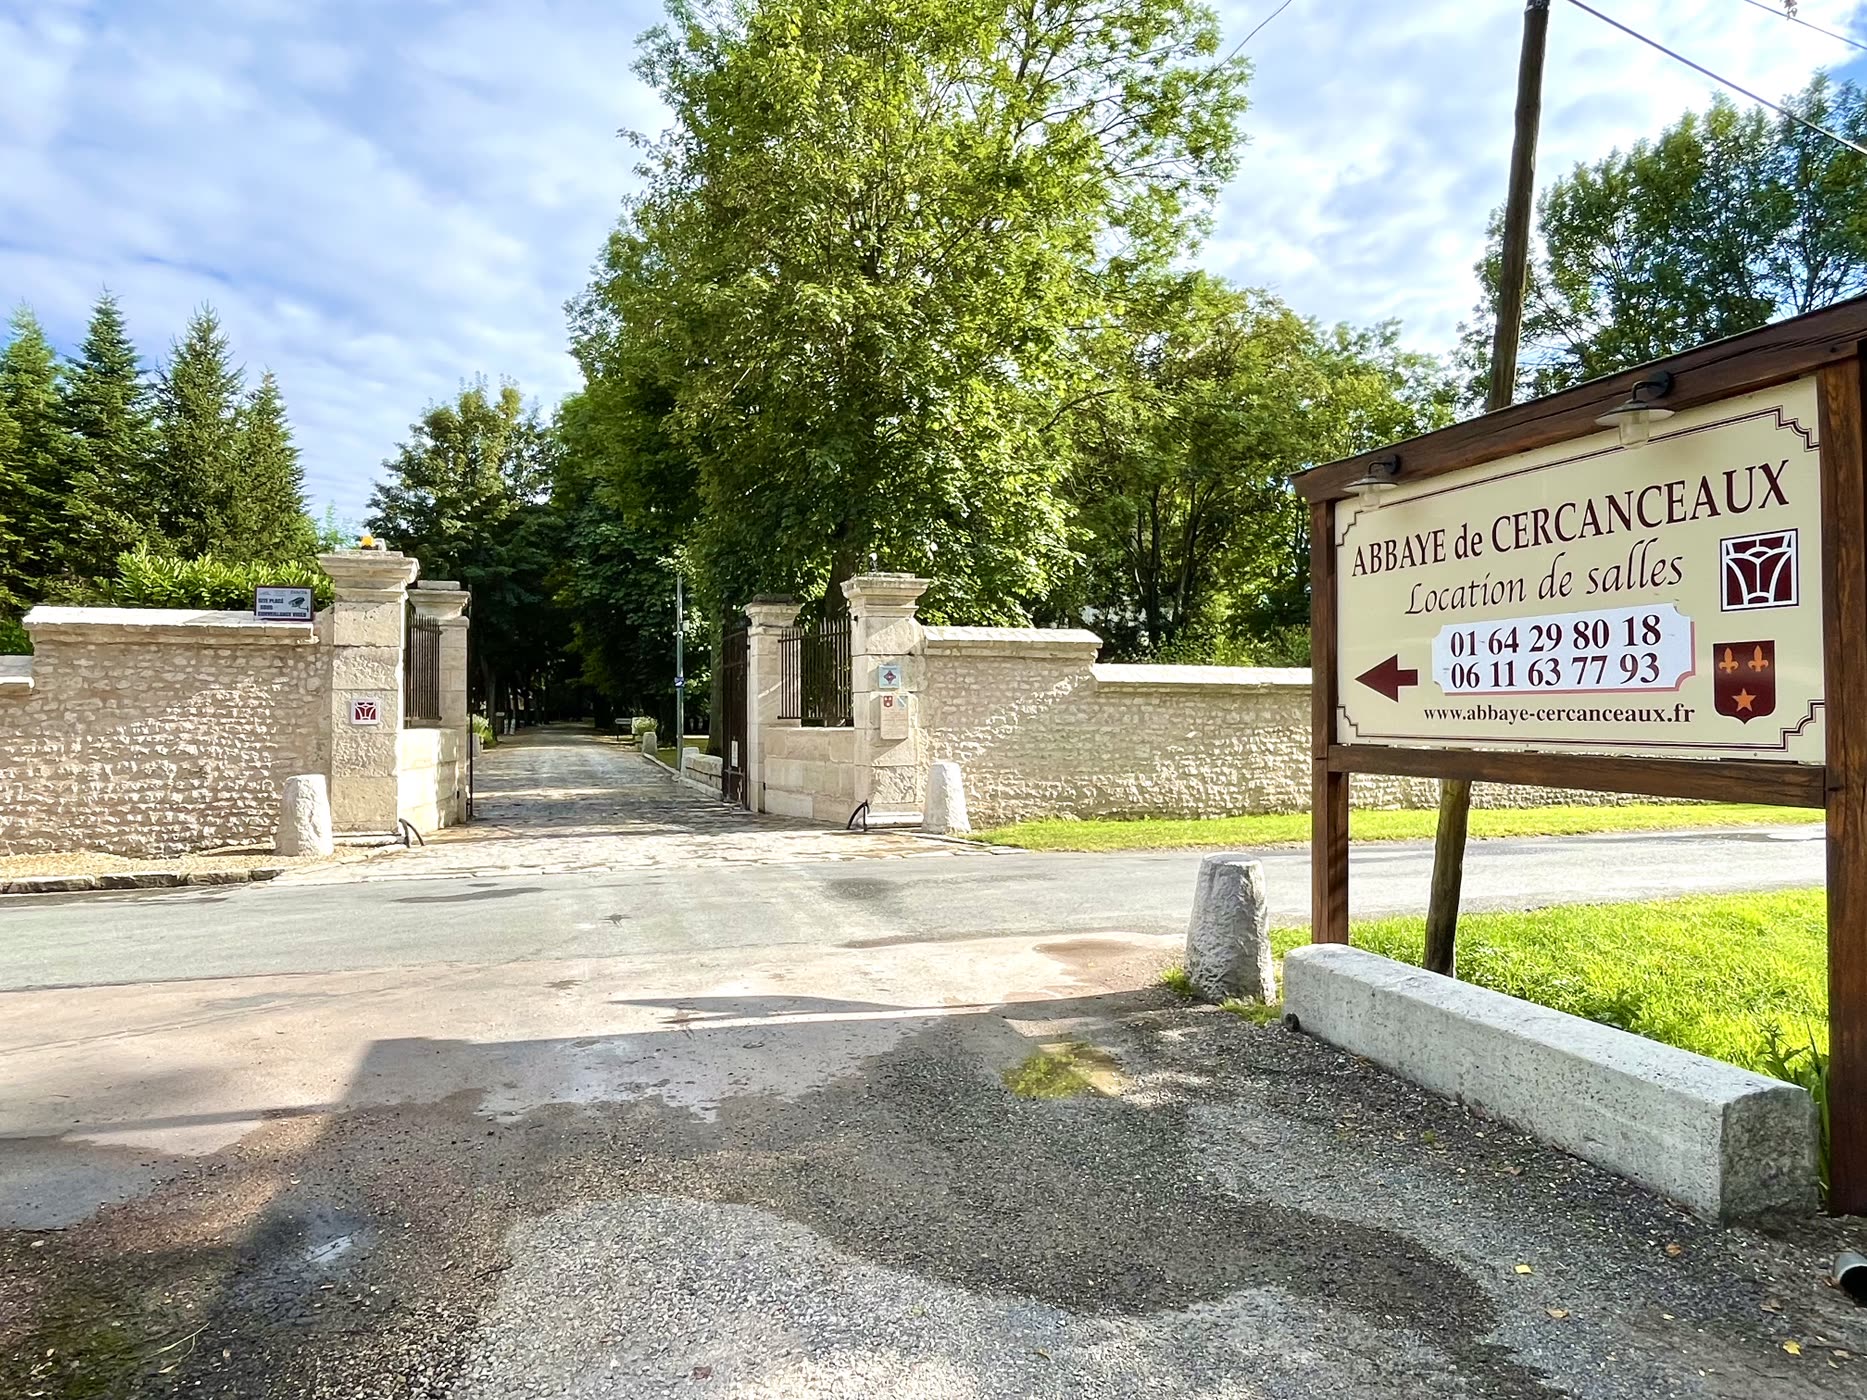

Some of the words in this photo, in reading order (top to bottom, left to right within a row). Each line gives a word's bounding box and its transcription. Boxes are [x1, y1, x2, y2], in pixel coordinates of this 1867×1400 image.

[1352, 529, 1446, 577] ABBAYE
[1454, 522, 1483, 560] de
[1491, 459, 1789, 553] CERCANCEAUX
[1404, 572, 1526, 615] Location
[1538, 551, 1572, 600] de
[1585, 537, 1683, 595] salles
[1450, 630, 1478, 658] 01
[1488, 626, 1519, 656] 64
[1528, 623, 1562, 653] 29
[1573, 618, 1610, 650] 80
[1622, 614, 1661, 647] 18
[1451, 662, 1480, 689] 06
[1489, 660, 1517, 687] 11
[1527, 657, 1561, 687] 63
[1571, 655, 1608, 685] 77
[1619, 652, 1660, 684] 93
[1424, 703, 1695, 725] www.abbaye-cercanceaux.fr
